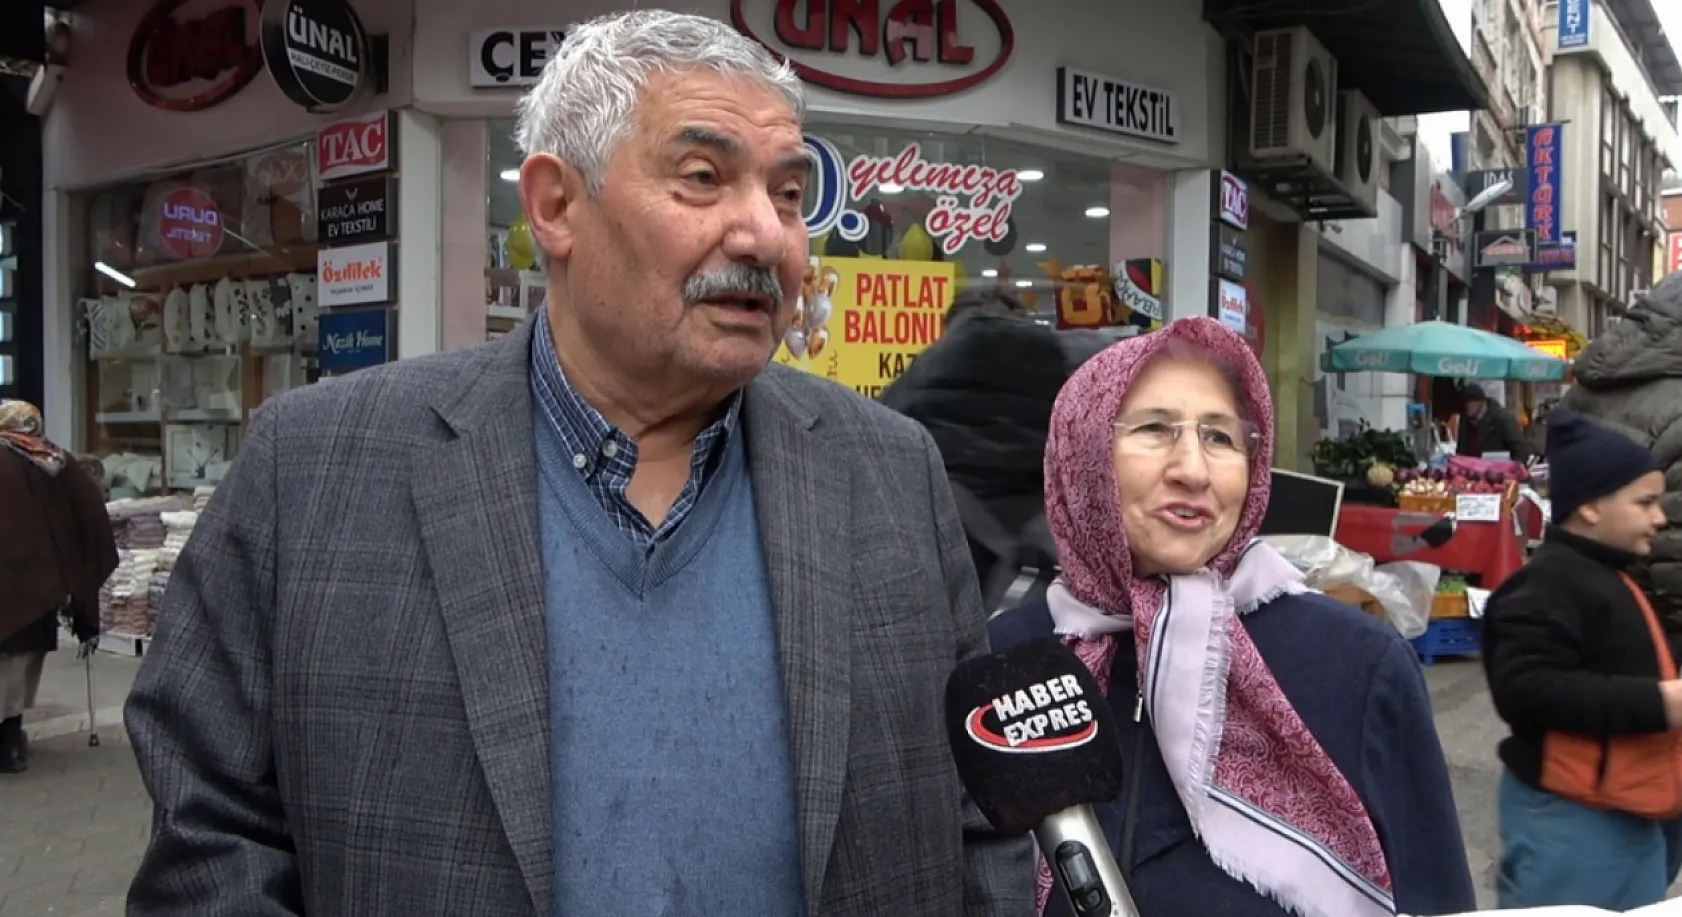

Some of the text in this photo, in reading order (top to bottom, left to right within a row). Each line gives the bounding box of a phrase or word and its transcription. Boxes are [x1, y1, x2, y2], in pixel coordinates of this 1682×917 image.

[289, 5, 358, 63] ÜNAL
[1073, 74, 1174, 136] EV TEKSTİL
[320, 198, 384, 221] KARACA HOME
[328, 222, 339, 238] EV
[928, 200, 1010, 252] özel
[323, 257, 382, 283] Özdilek
[856, 273, 949, 308] PATLAT
[992, 674, 1084, 721] HABER
[1003, 700, 1093, 747] EXPRES
